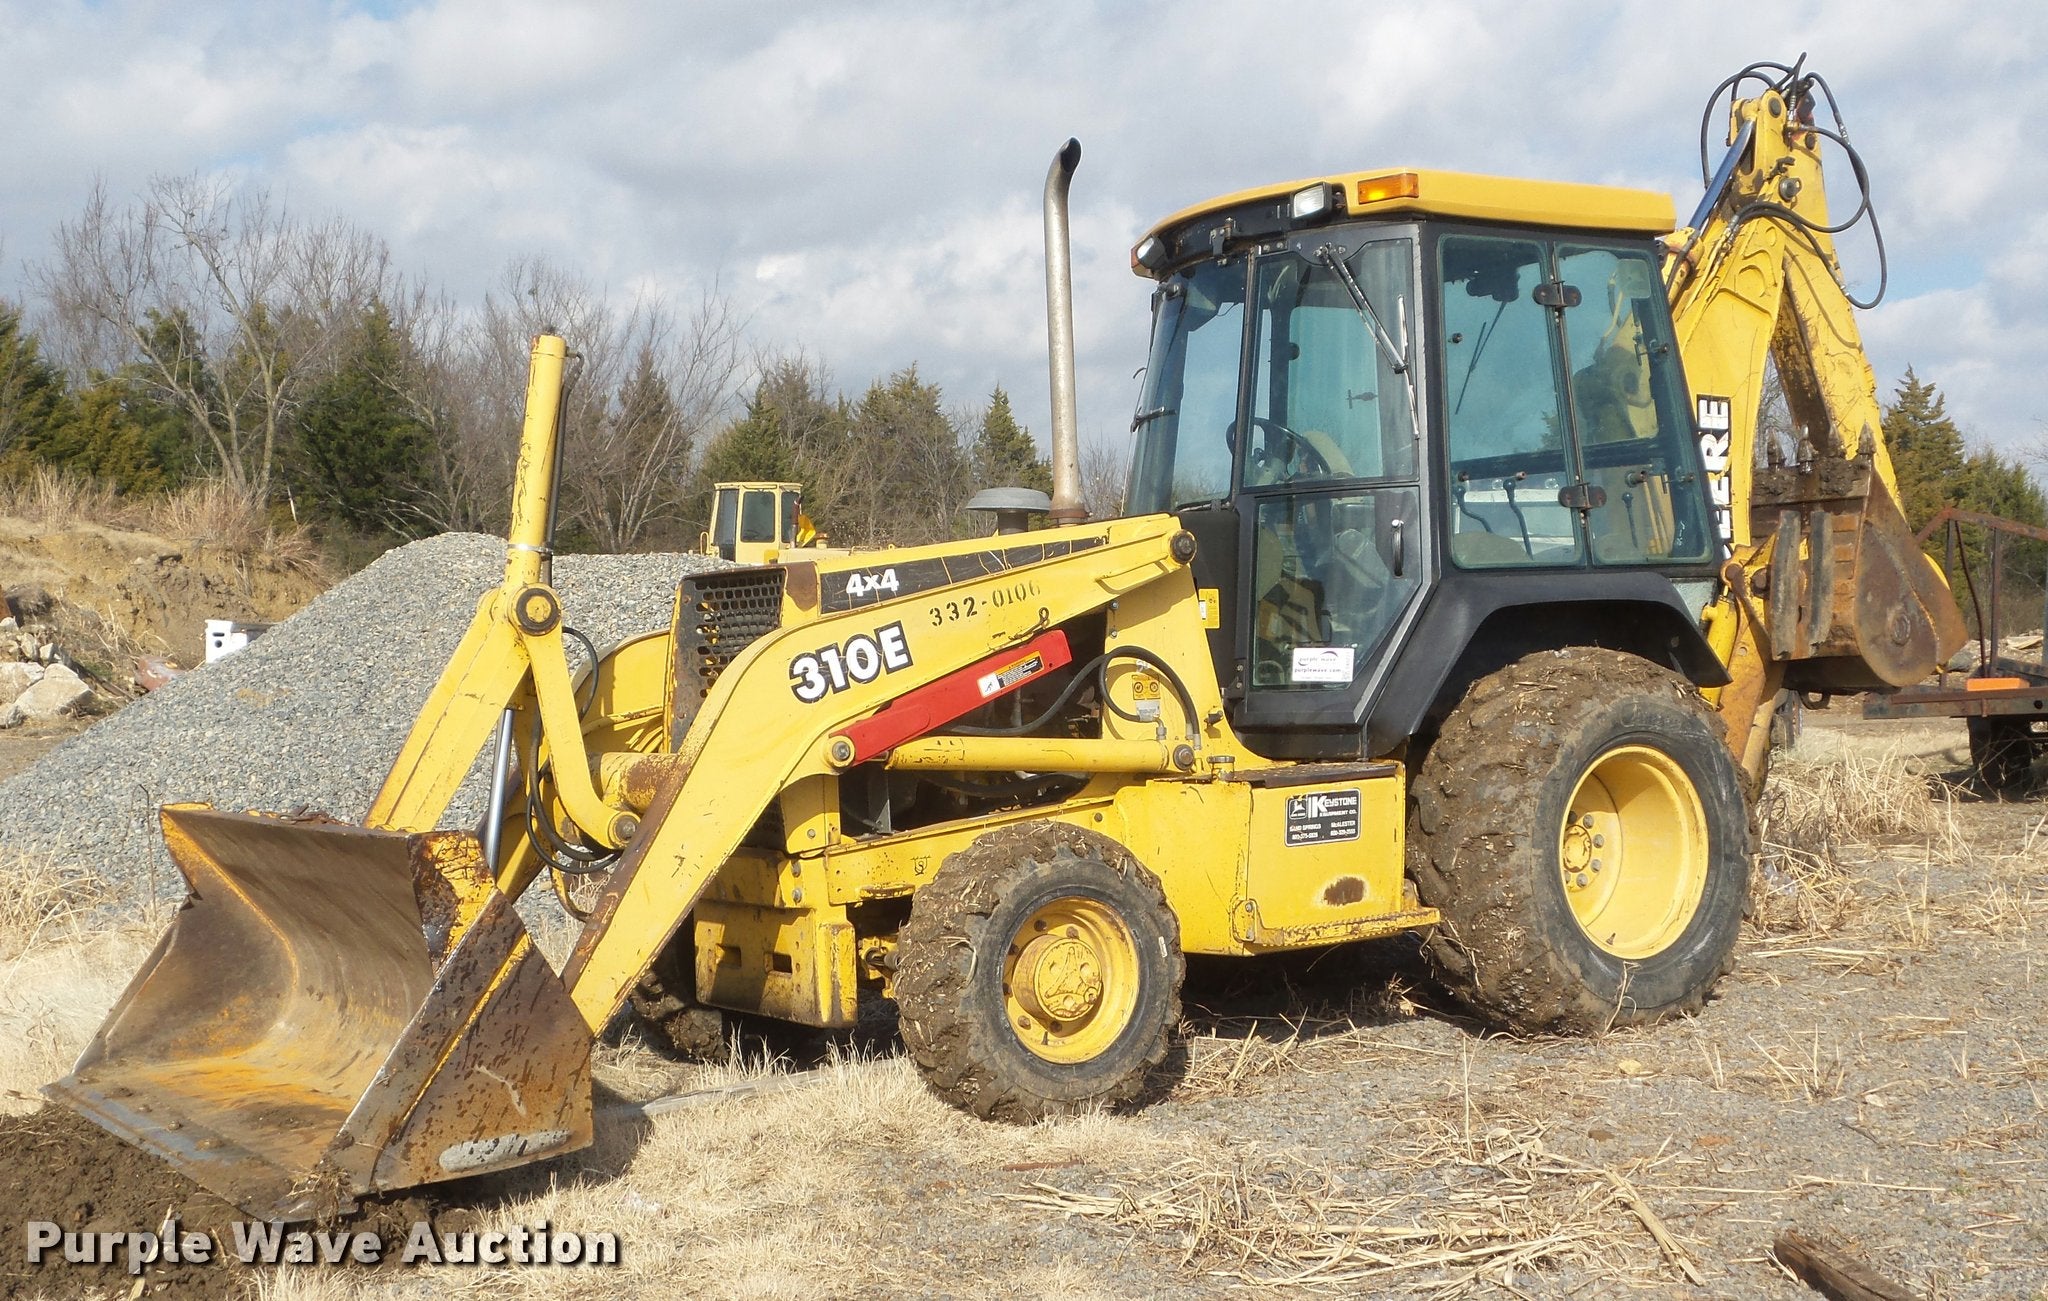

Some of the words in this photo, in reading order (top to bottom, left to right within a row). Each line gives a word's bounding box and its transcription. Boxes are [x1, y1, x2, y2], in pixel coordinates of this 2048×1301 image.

[1698, 397, 1732, 560] EERE
[846, 568, 900, 597] 4x4
[929, 580, 1041, 627] 332-0106
[790, 622, 913, 703] 310E
